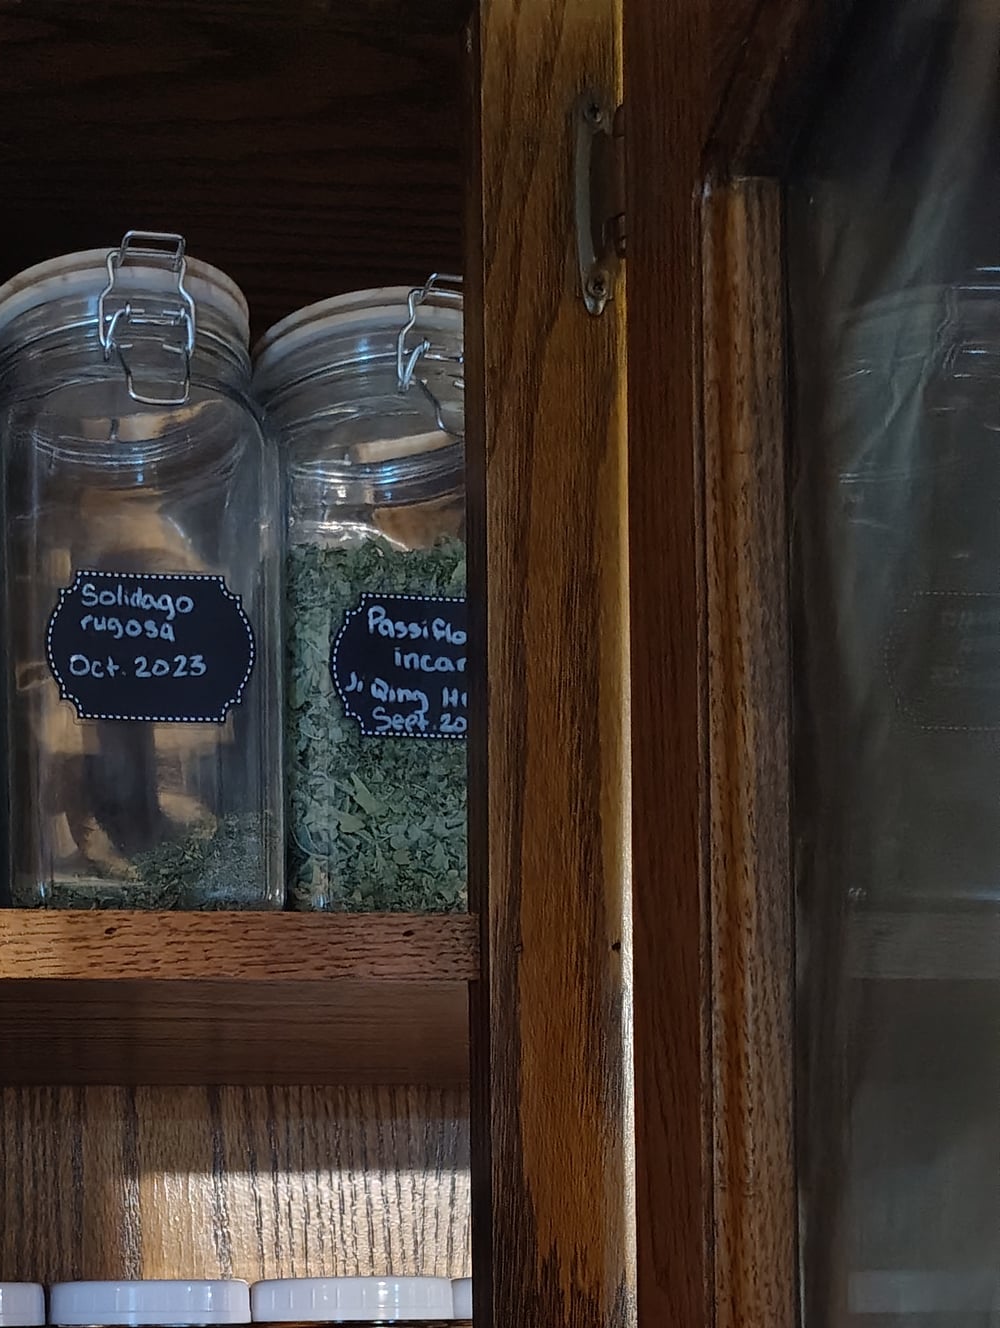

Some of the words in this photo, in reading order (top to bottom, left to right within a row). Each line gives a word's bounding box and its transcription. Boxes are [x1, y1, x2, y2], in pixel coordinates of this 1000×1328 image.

[80, 583, 195, 620] Solidago
[79, 614, 176, 643] rugosa
[68, 653, 128, 679] Oct.
[134, 653, 207, 678] 2023
